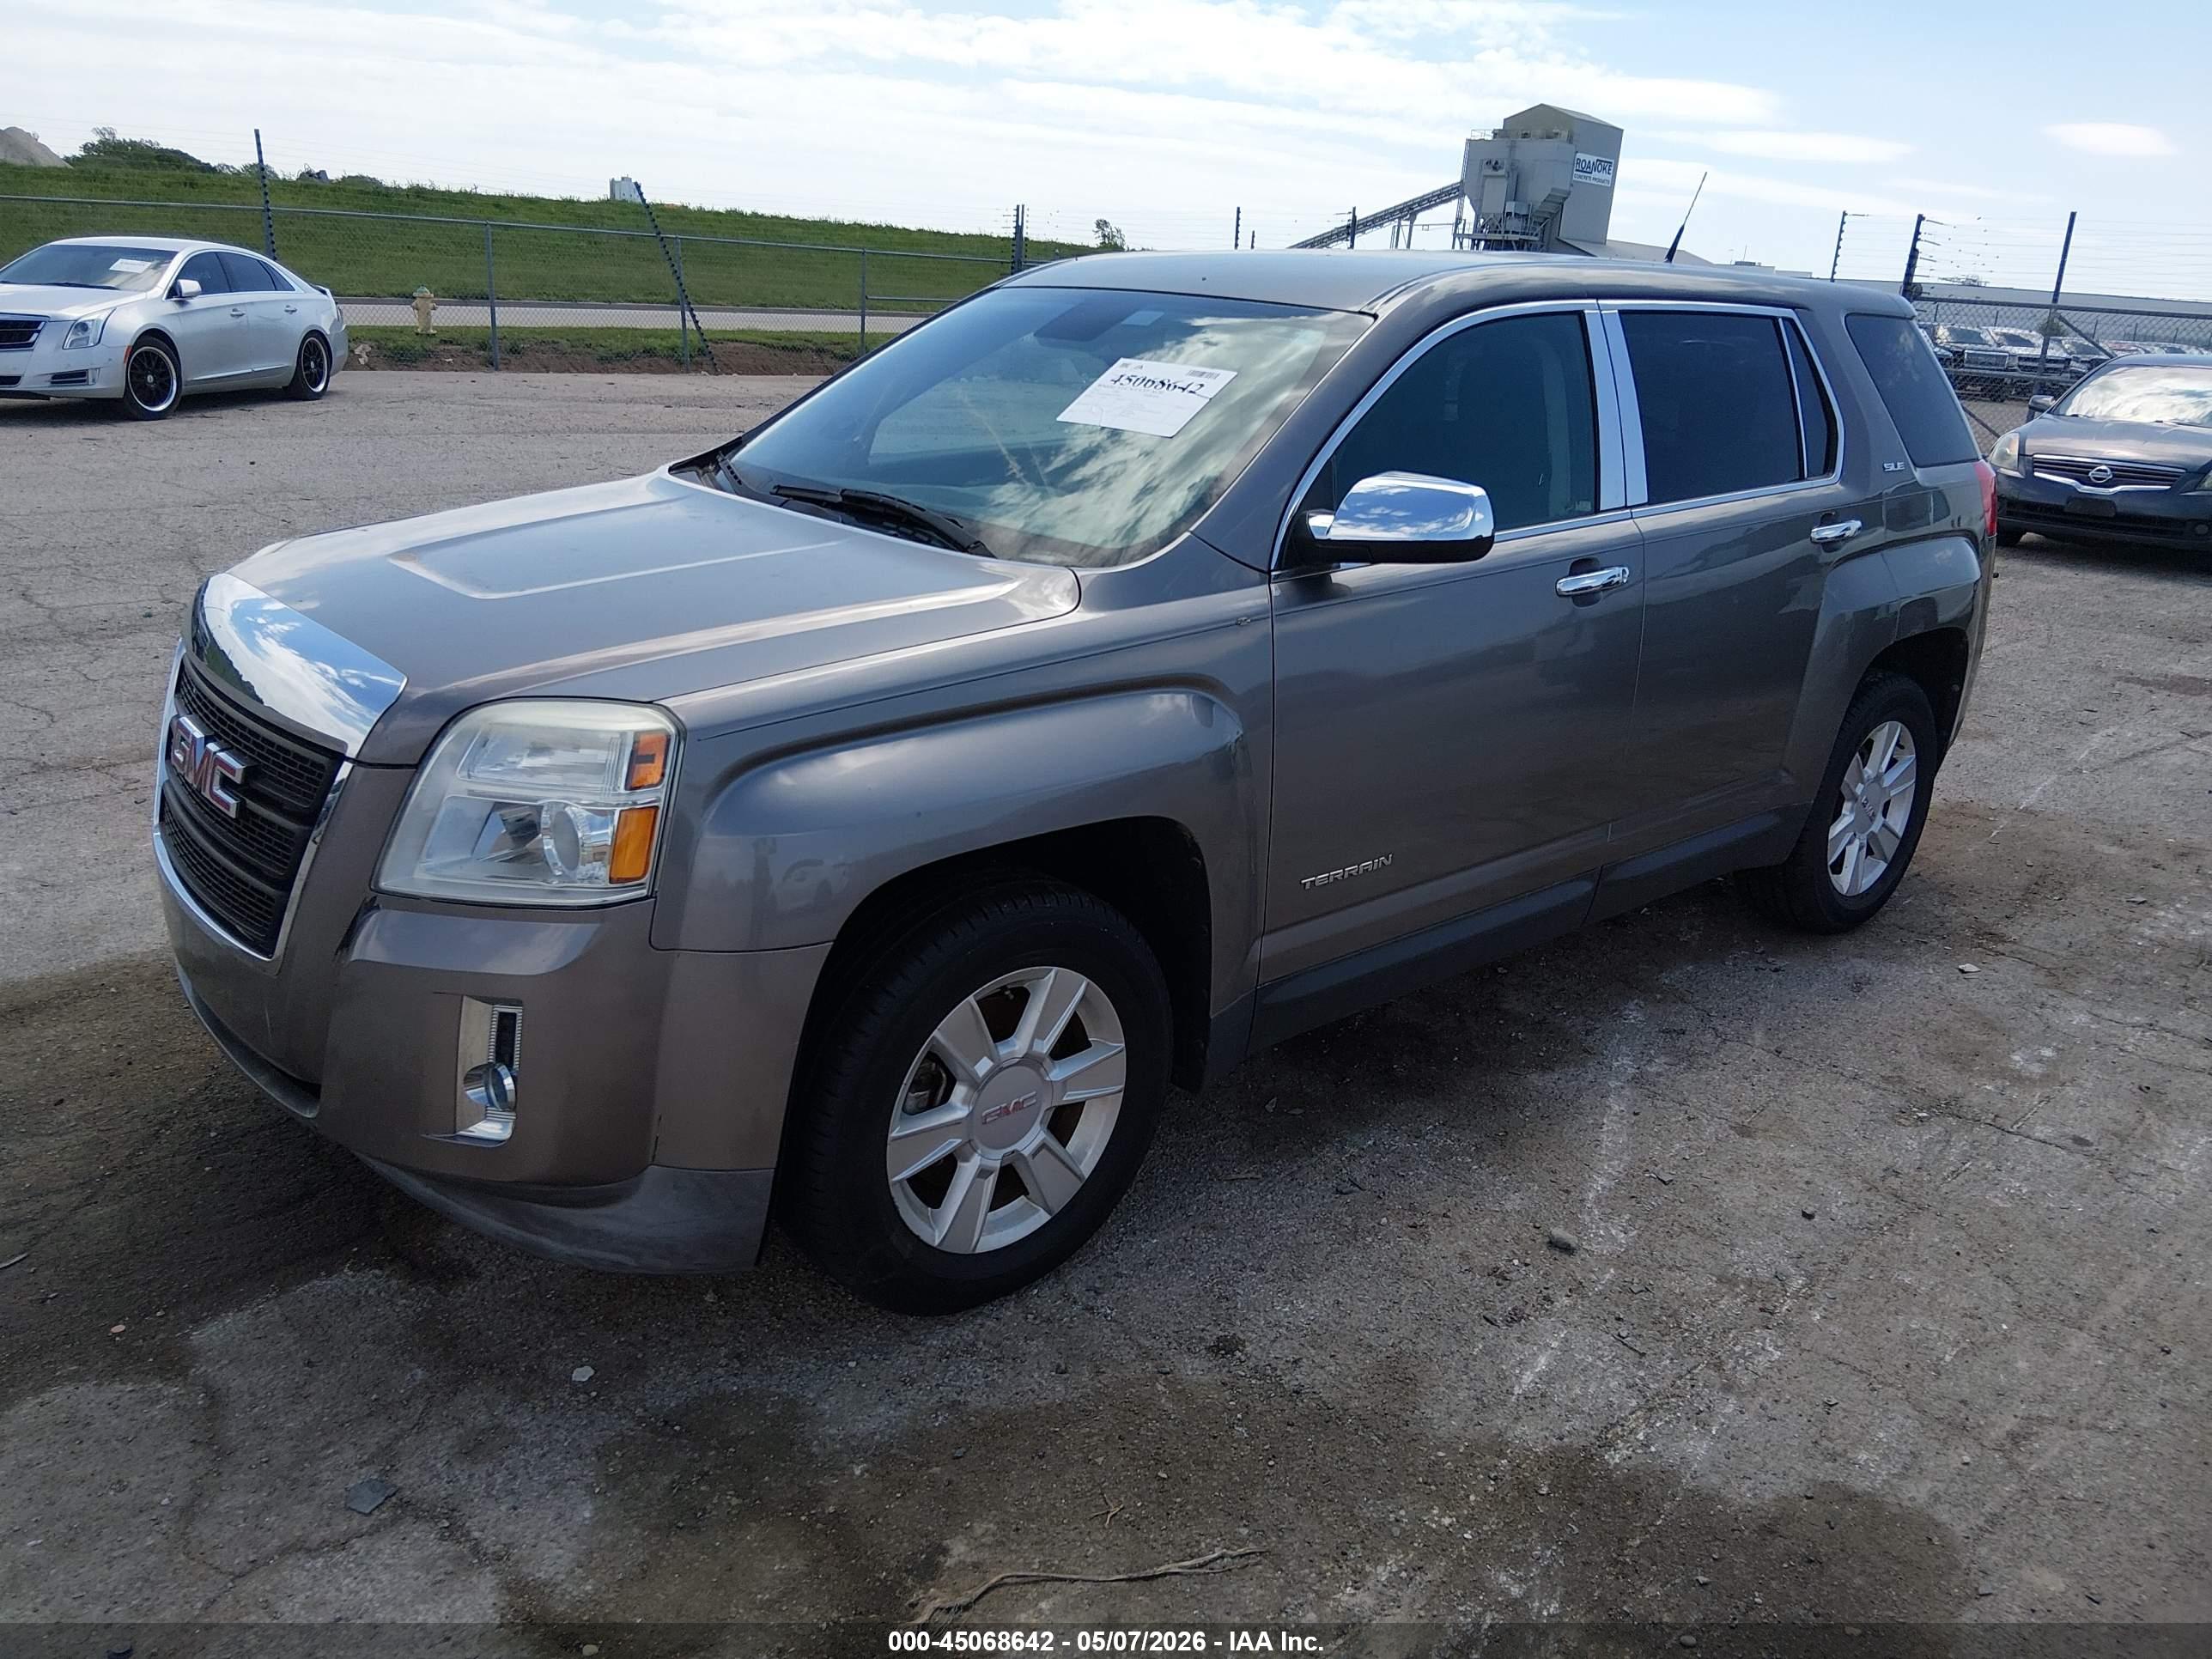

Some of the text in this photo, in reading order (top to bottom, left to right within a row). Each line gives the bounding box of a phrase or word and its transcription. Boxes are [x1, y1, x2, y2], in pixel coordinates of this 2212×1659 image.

[1576, 158, 1613, 175] ROANOKE
[1110, 374, 1205, 394] 45068642
[1883, 462, 1905, 472] SLE
[171, 716, 247, 818] GMC
[1301, 854, 1393, 890] TERRAIN
[981, 1091, 1037, 1125] GMC
